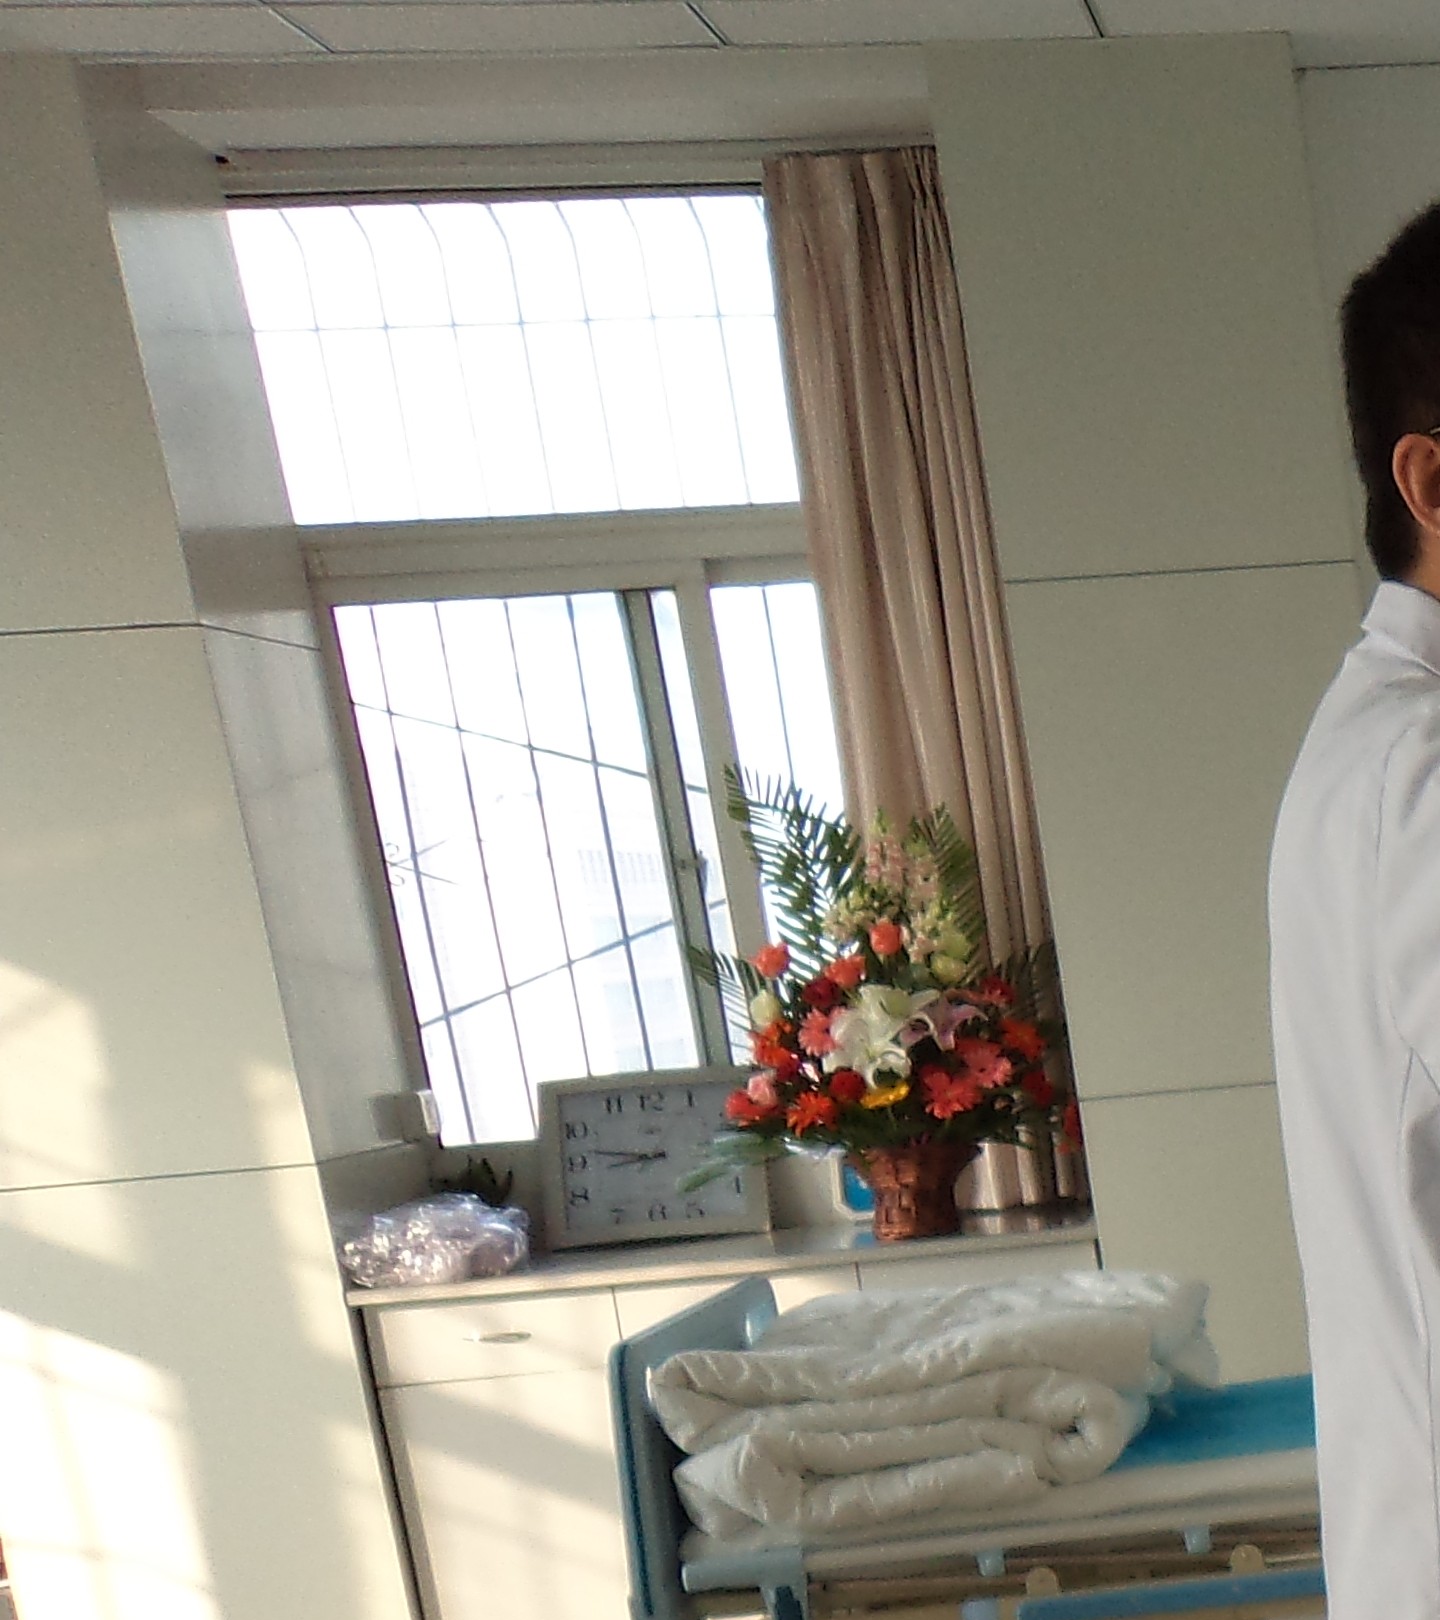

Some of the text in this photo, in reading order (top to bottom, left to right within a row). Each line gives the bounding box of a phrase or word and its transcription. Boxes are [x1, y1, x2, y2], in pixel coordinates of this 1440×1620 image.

[605, 1095, 623, 1114] 11
[639, 1092, 664, 1111] 12
[565, 1121, 588, 1140] 10
